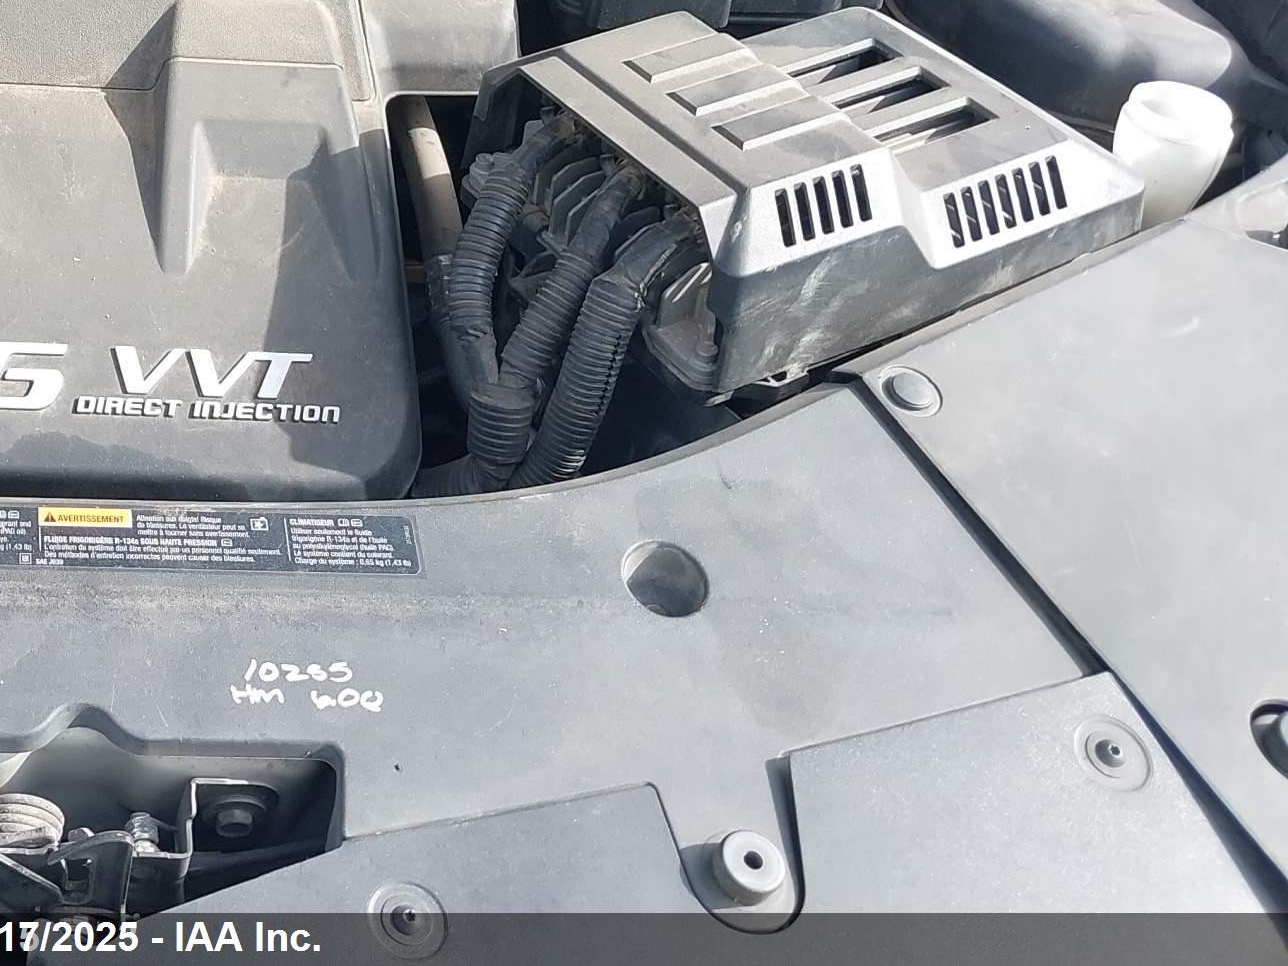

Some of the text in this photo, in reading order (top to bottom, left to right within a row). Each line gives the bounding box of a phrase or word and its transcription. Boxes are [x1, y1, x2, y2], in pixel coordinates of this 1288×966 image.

[111, 345, 313, 400] VVT
[73, 395, 341, 423] DIRECT INJECTION
[58, 514, 124, 523] AVERTISSEMENT
